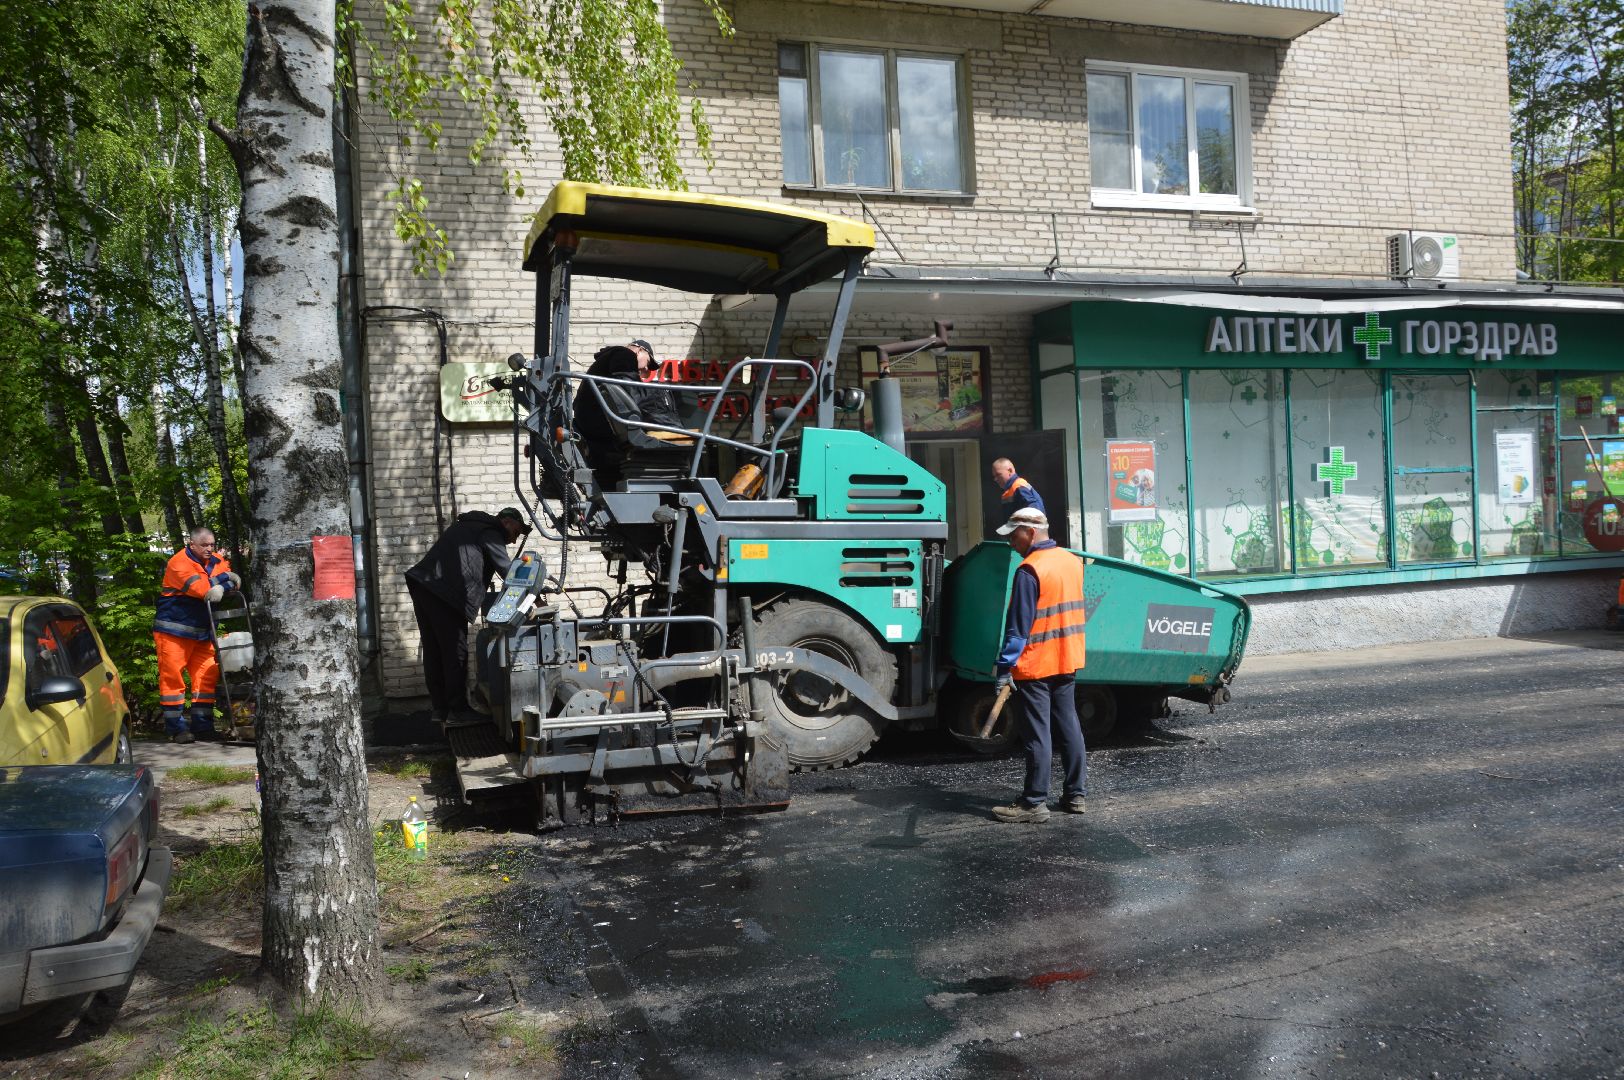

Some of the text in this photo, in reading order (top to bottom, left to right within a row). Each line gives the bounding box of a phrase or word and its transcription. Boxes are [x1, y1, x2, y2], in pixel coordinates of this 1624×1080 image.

[1207, 316, 1558, 360] АПТЕКИ ГОРЗДРАВ
[1147, 616, 1213, 636] VÖGELE
